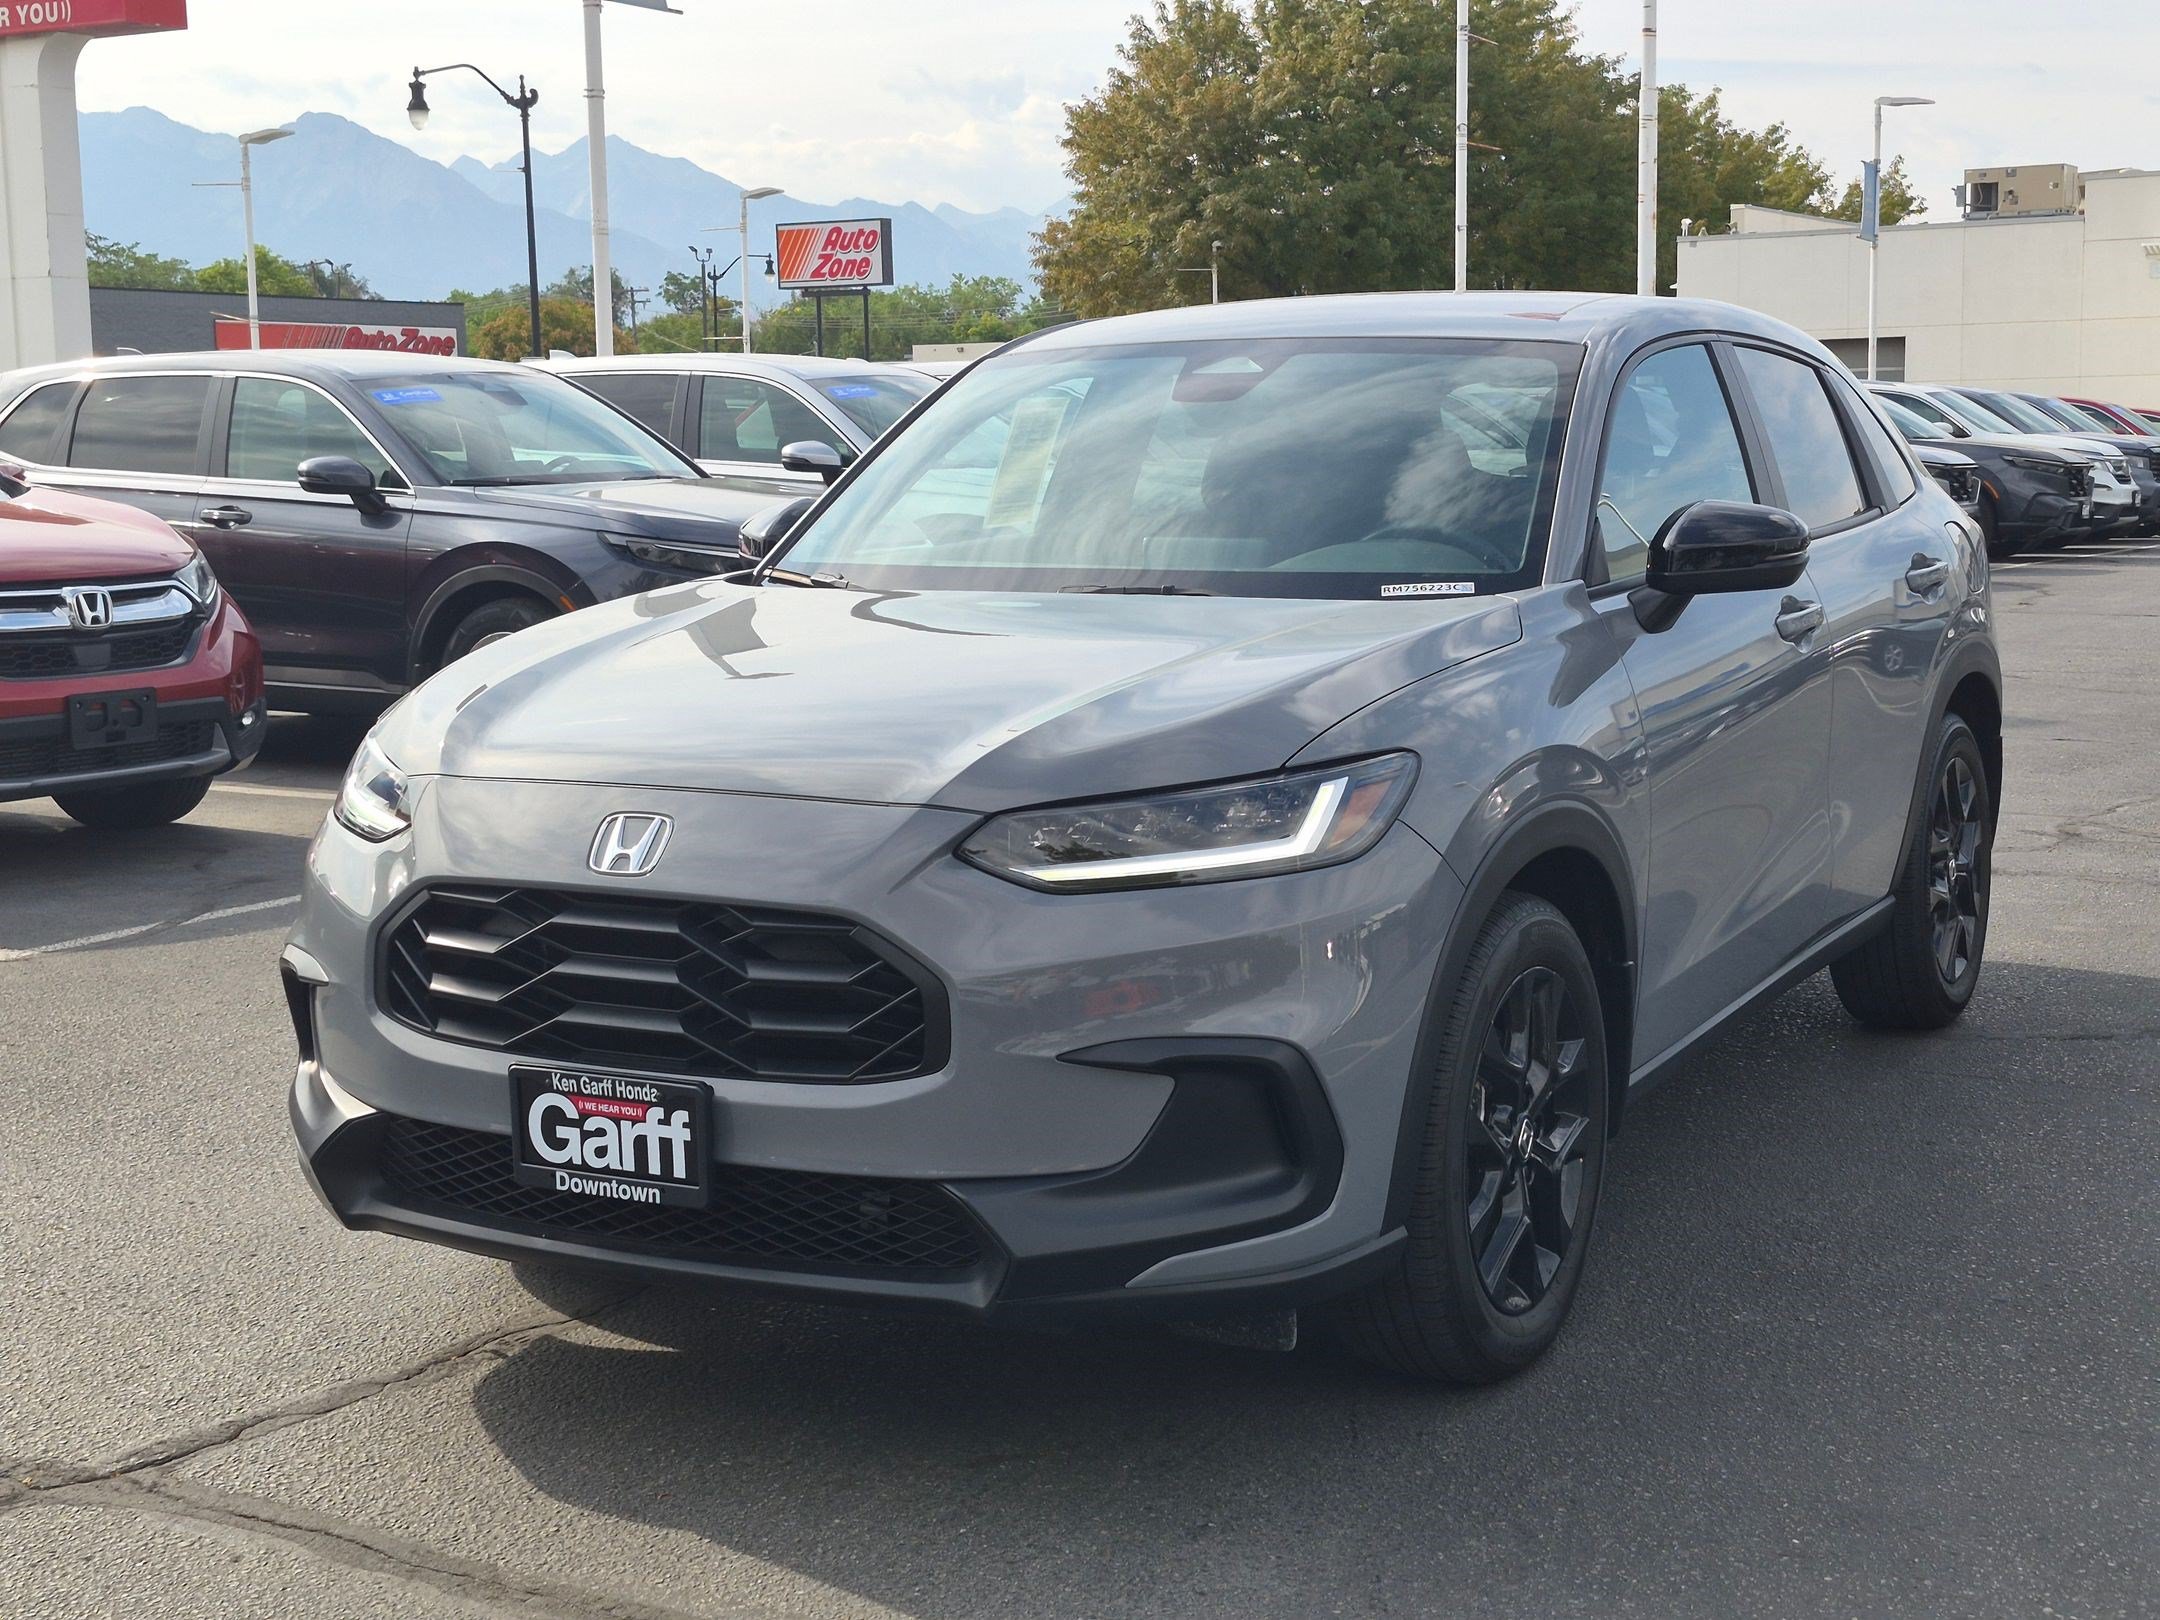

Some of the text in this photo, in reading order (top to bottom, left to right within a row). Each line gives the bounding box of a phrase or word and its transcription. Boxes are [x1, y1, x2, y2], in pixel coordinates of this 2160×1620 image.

[821, 226, 879, 253] Auto
[809, 253, 870, 279] Zone
[551, 1072, 659, 1103] Ken Garff Honda
[584, 1101, 637, 1116] WE HEAR YOU
[528, 1092, 692, 1179] Garff
[555, 1170, 661, 1204] Downtown
